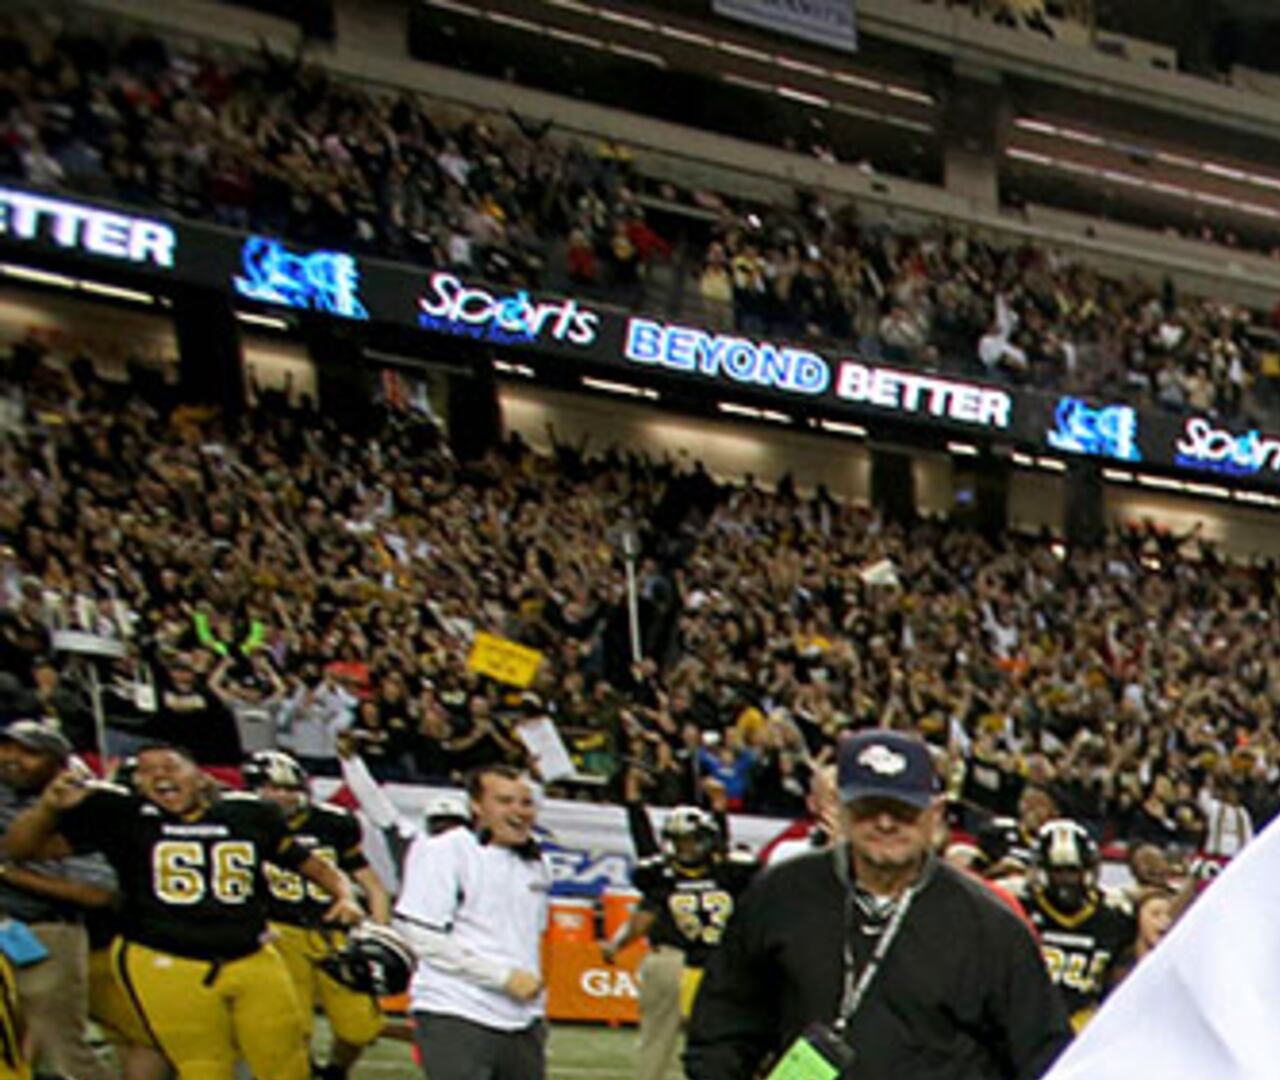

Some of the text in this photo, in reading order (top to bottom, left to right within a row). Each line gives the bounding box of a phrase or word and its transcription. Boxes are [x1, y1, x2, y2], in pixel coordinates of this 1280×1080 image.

[418, 272, 600, 345] Sports
[625, 317, 1012, 428] BEYOND BETTER
[153, 840, 256, 904] 66
